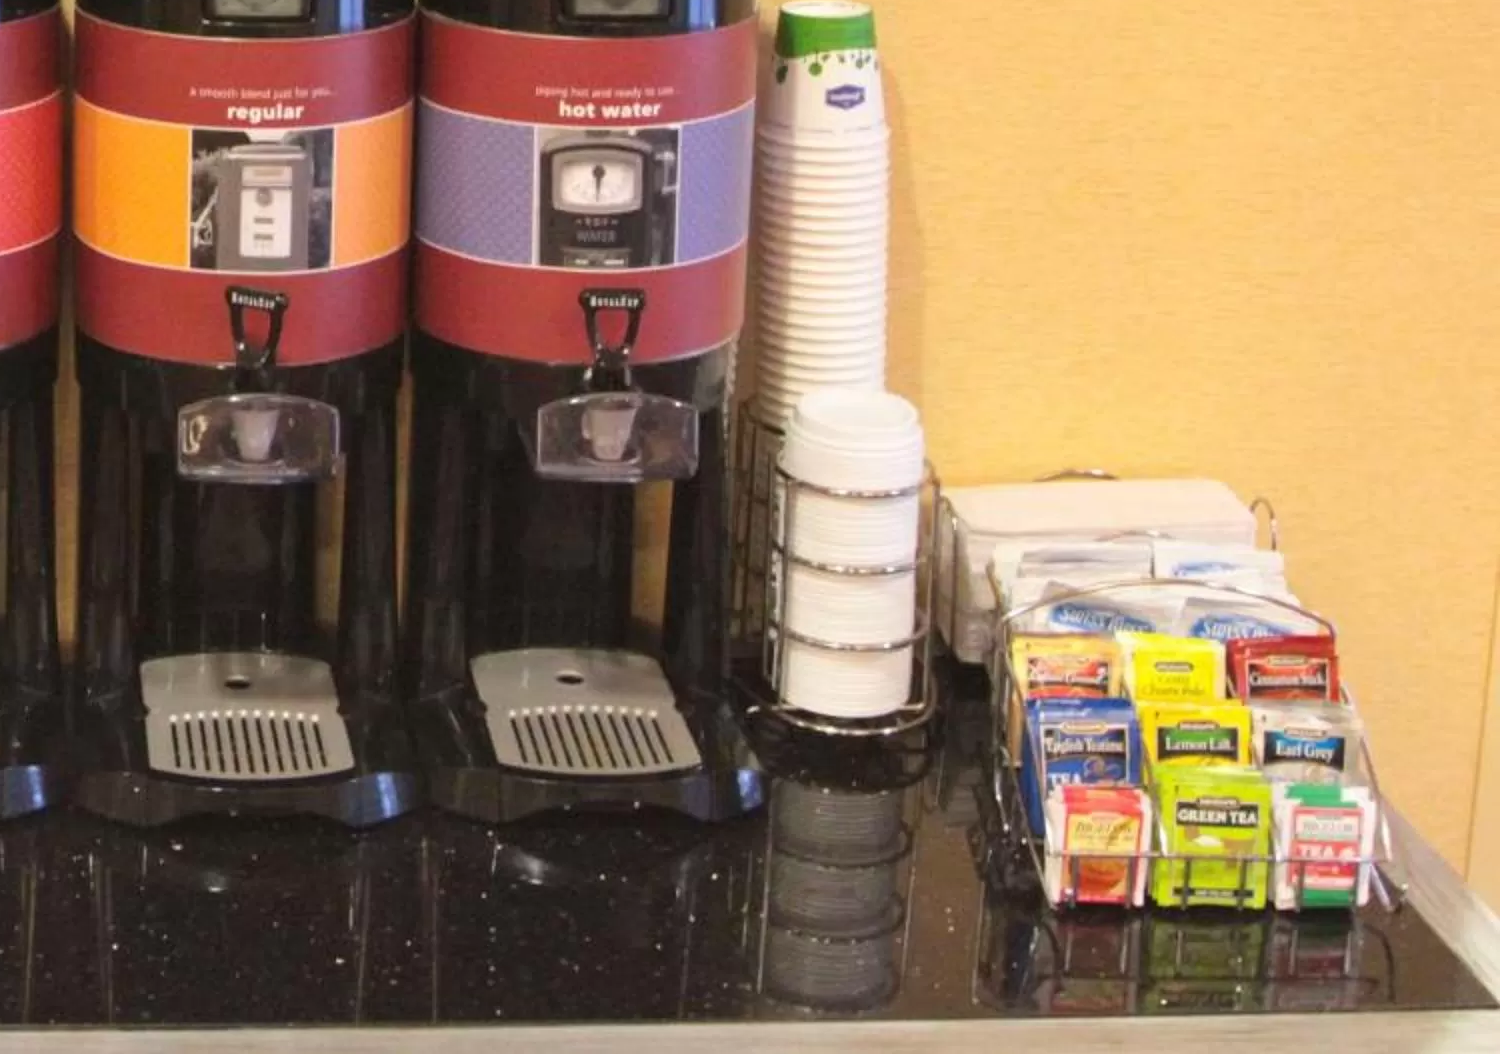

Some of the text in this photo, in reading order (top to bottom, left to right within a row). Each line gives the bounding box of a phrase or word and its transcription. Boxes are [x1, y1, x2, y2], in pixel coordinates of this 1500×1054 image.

[227, 102, 305, 124] regular
[558, 98, 662, 120] hot water
[1165, 736, 1207, 751] Lemon
[1275, 739, 1334, 764] Earl Grey
[1177, 808, 1258, 825] GREEN TEA
